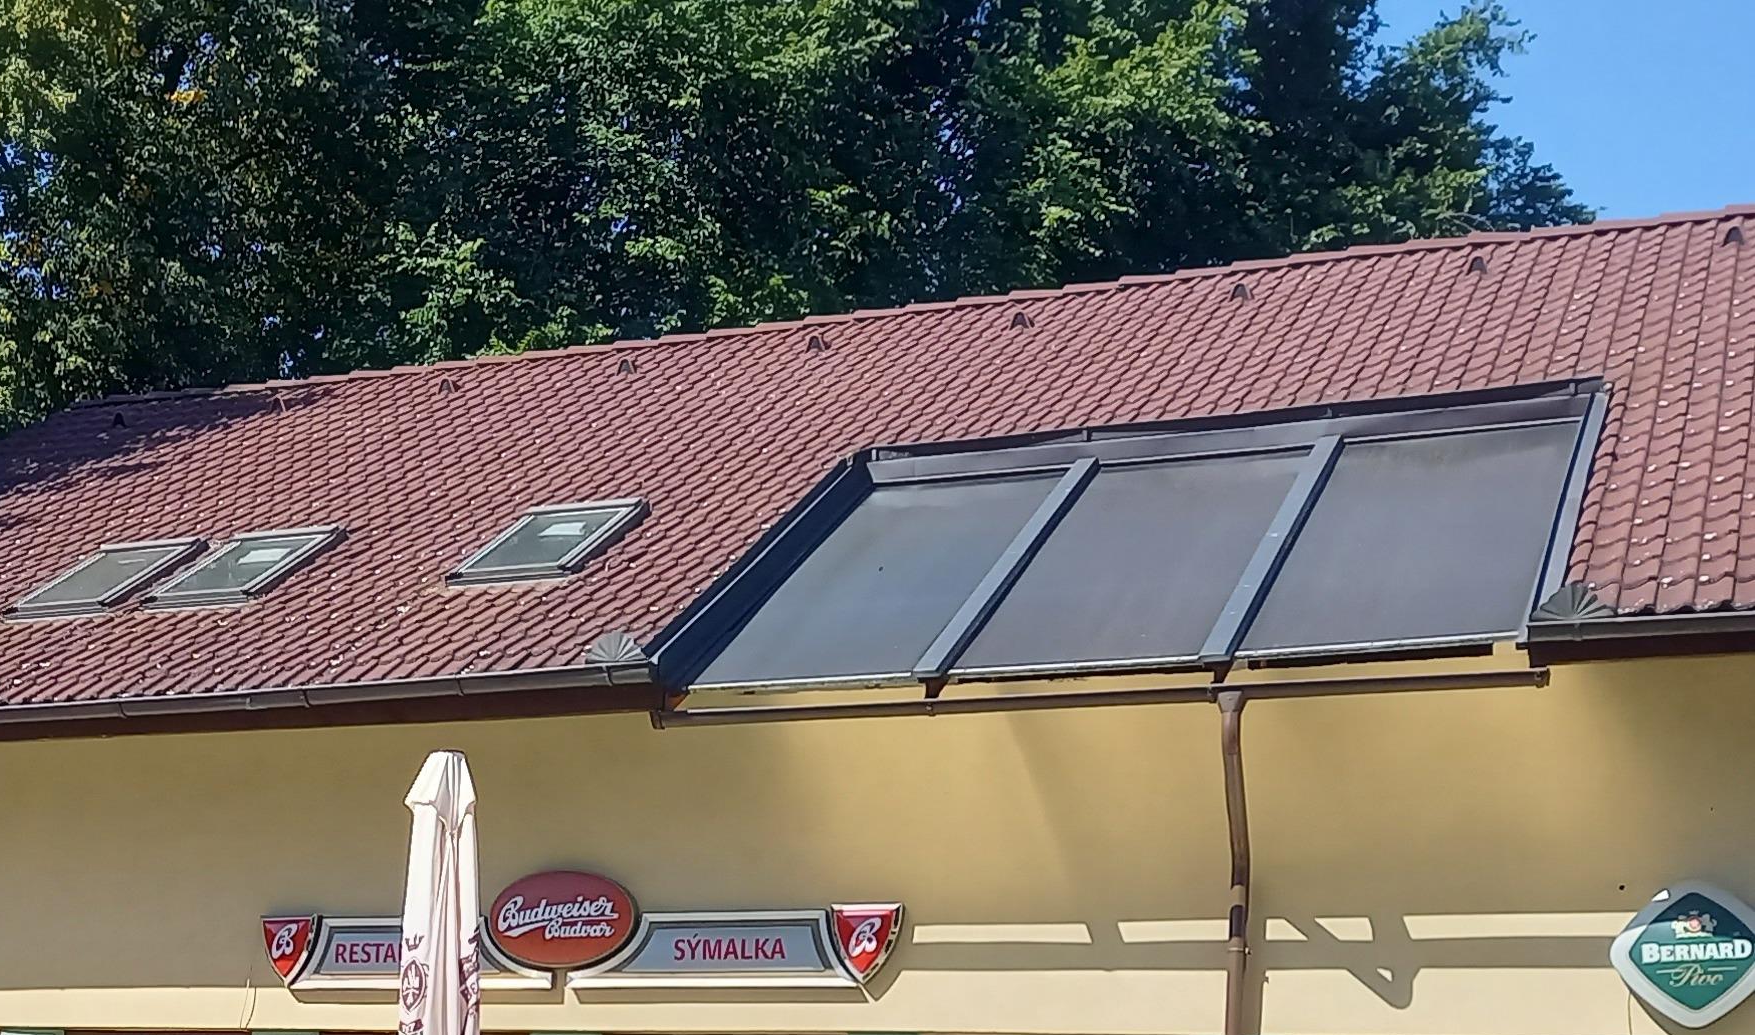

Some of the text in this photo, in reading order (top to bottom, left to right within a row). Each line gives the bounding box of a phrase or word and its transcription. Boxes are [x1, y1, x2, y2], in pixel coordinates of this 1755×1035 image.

[498, 895, 619, 934] Budweiser
[545, 918, 615, 940] Budvar
[335, 933, 786, 963] RESTA SÝMALKA
[1641, 939, 1752, 964] BERNARD
[1669, 963, 1723, 987] Pivo
